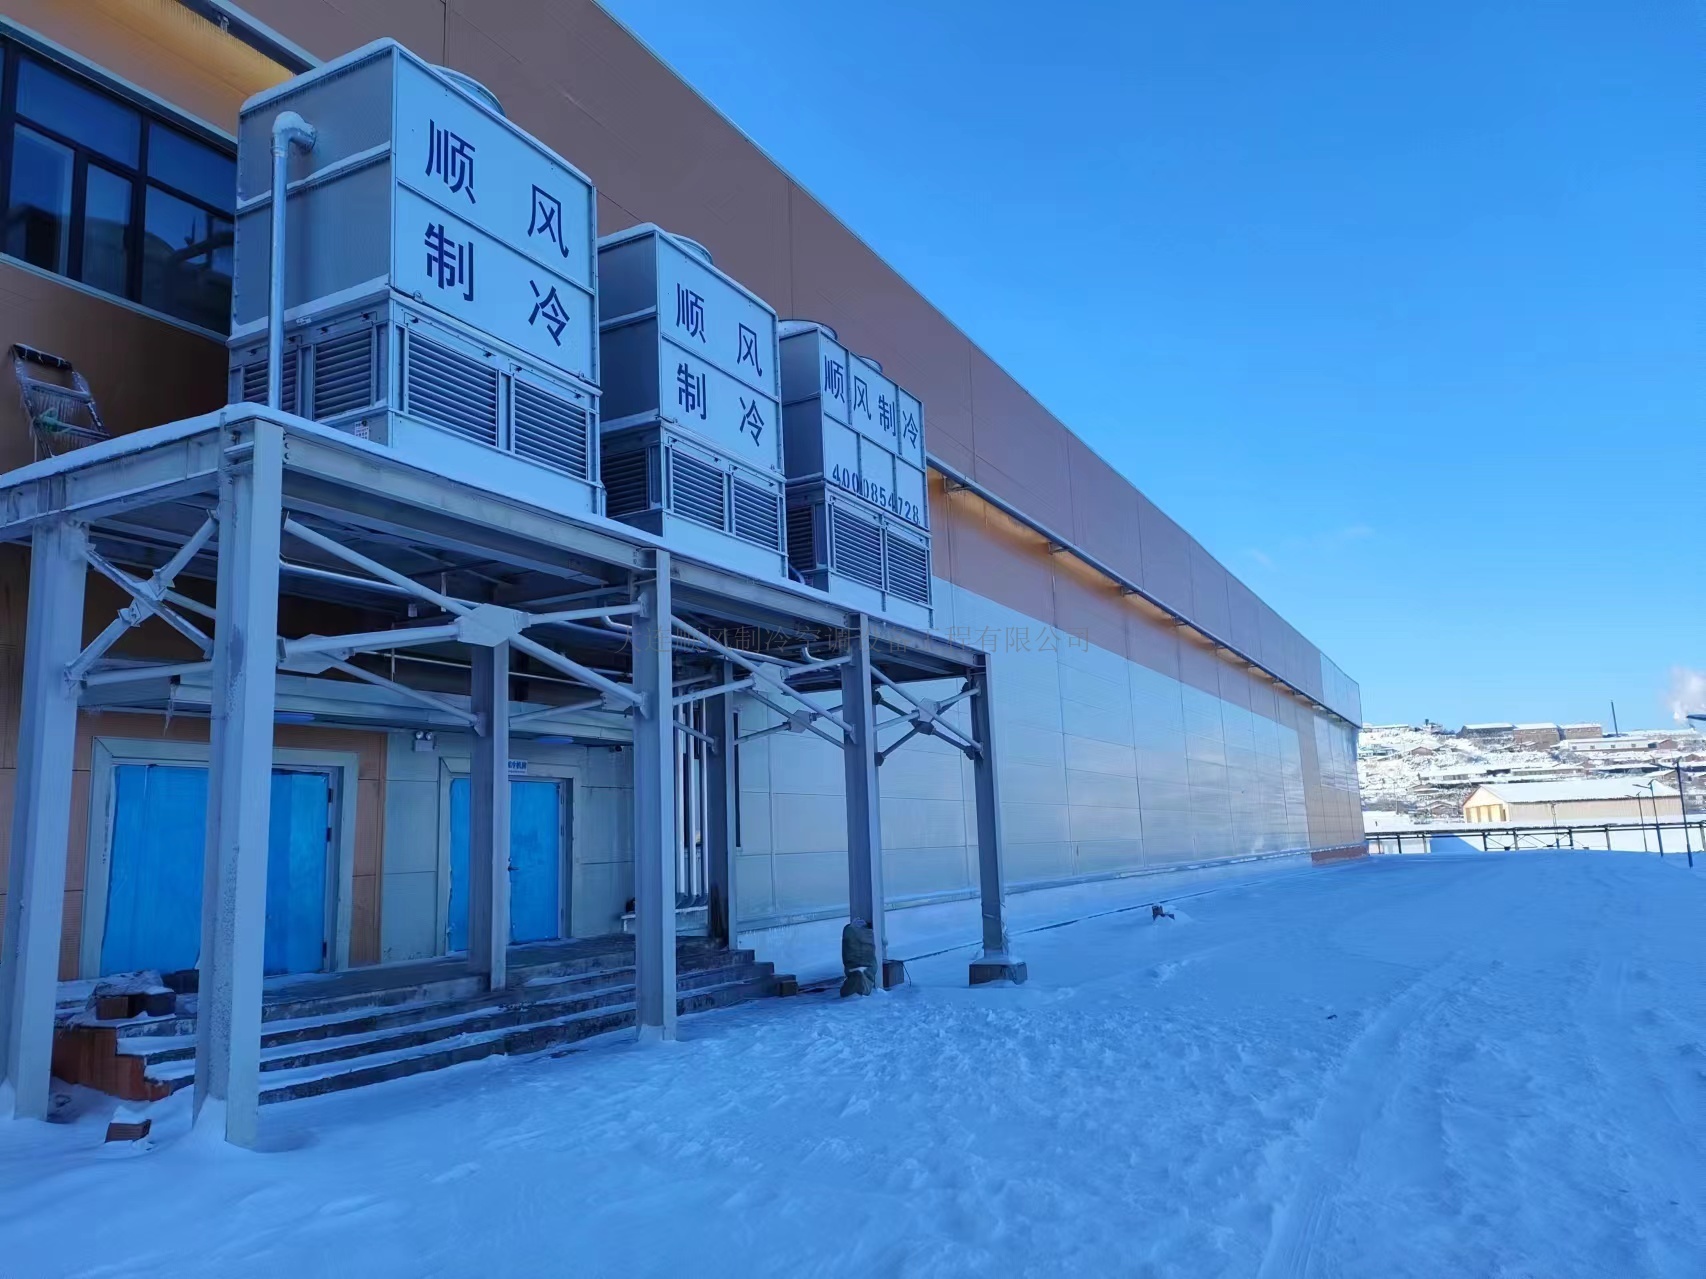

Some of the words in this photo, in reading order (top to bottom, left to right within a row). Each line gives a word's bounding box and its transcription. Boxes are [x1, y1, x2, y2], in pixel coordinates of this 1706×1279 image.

[425, 118, 569, 258] 顺风
[424, 222, 570, 347] 制冷
[676, 282, 762, 377] 顺风
[676, 362, 764, 447] 制冷
[824, 355, 919, 449] 顺风制冷
[832, 463, 920, 525] 4000854728
